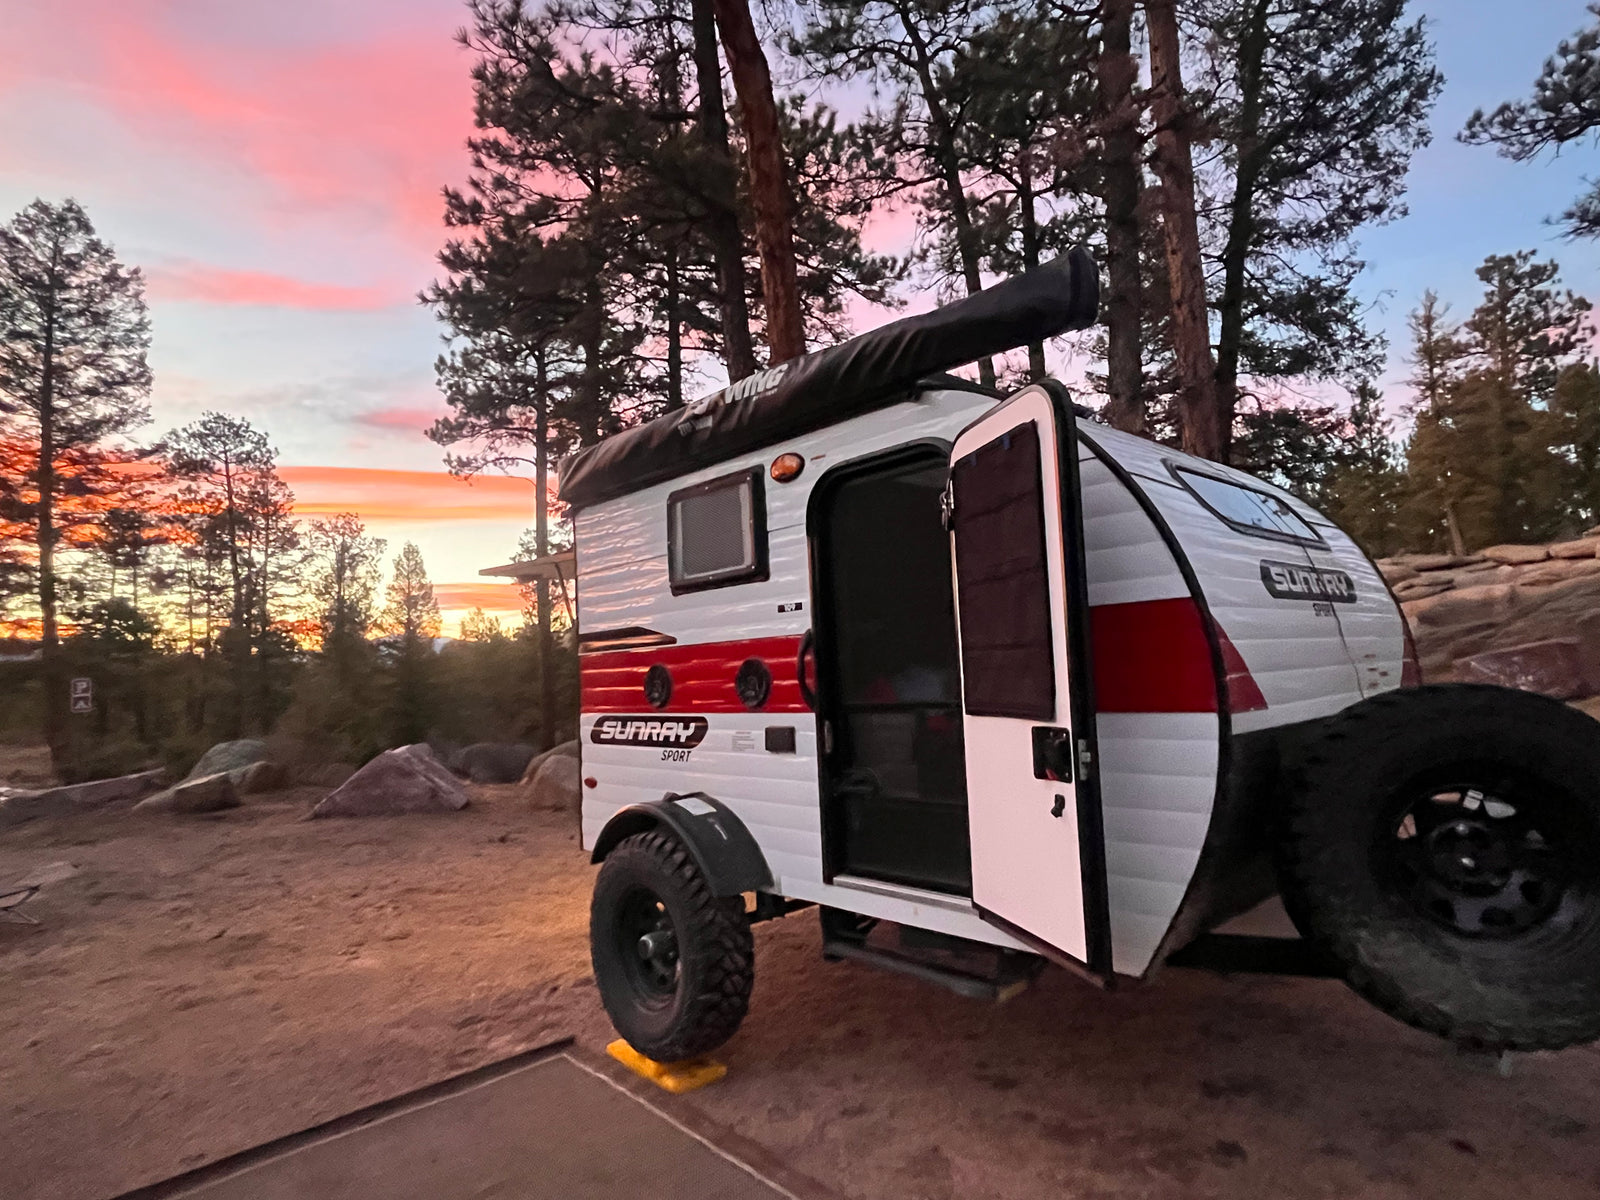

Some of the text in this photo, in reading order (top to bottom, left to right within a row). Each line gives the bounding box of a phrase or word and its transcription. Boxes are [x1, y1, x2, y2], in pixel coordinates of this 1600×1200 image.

[1269, 566, 1348, 597] SUNRAY
[600, 721, 696, 743] SUNRAY
[661, 750, 692, 762] SPORT
